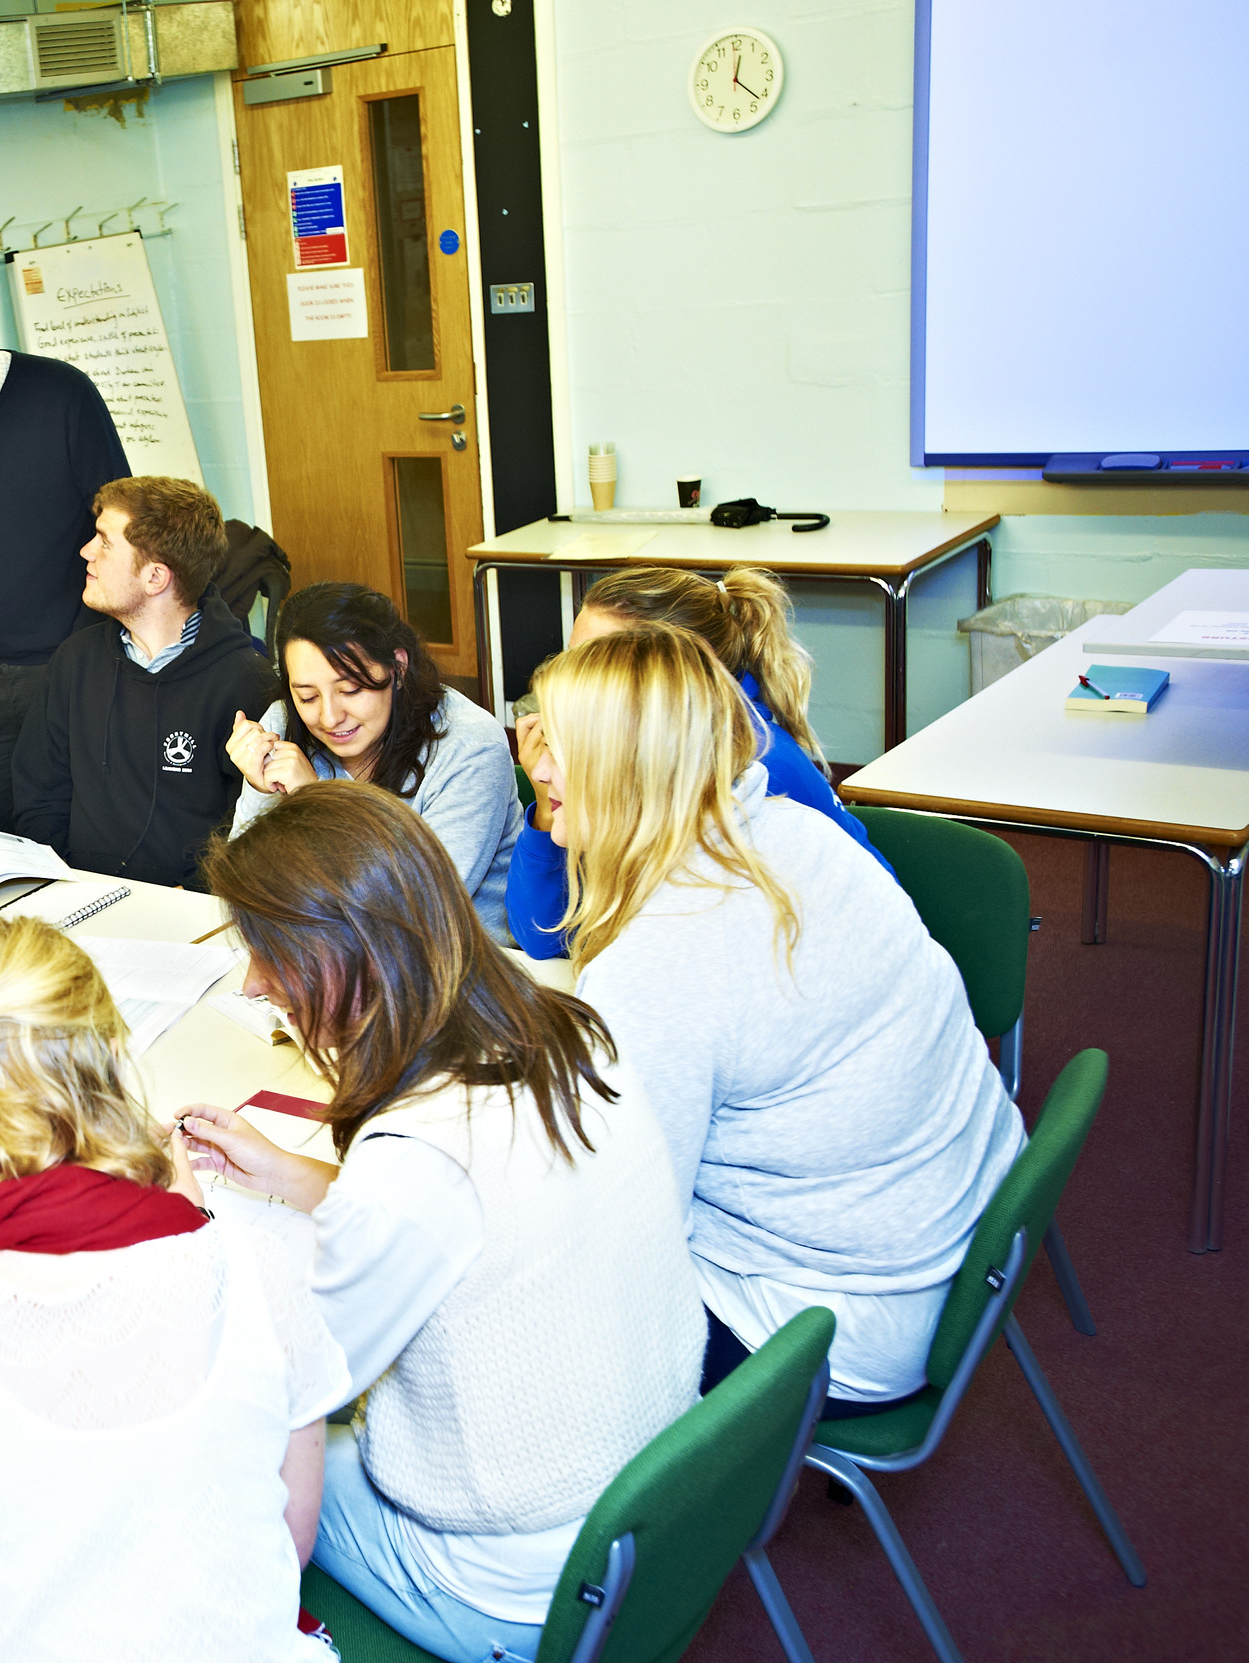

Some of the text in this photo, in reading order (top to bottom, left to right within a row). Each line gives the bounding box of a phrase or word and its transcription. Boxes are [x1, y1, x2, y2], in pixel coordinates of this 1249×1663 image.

[732, 39, 742, 51] 12
[717, 48, 726, 58] 11
[761, 52, 769, 64] 2
[707, 60, 718, 72] 10
[765, 70, 774, 82] 3
[700, 79, 709, 91] 9
[761, 88, 769, 98] 4
[705, 95, 714, 107] 8
[750, 101, 758, 113] 5
[717, 105, 725, 117] 7
[732, 108, 741, 120] 6
